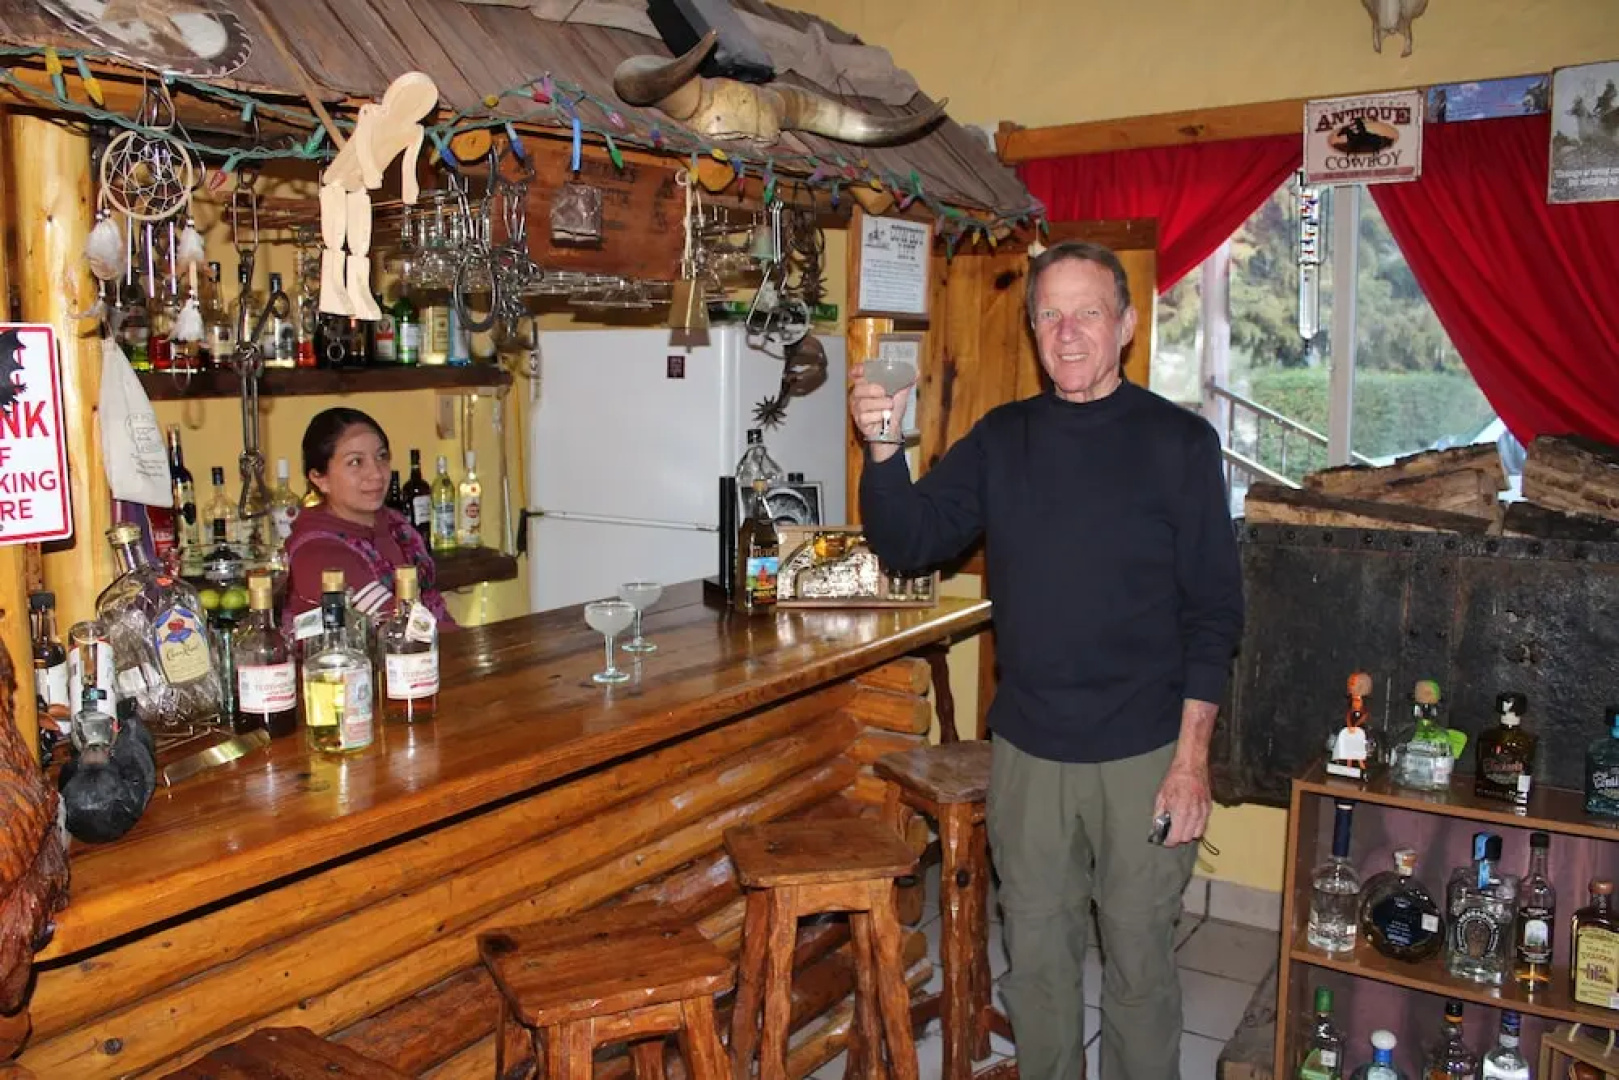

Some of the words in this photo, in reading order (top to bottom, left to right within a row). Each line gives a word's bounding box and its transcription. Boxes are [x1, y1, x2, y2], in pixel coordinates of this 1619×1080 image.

[1314, 106, 1411, 133] ANTIQUE
[1325, 149, 1402, 170] COWBOY
[0, 498, 33, 520] RE
